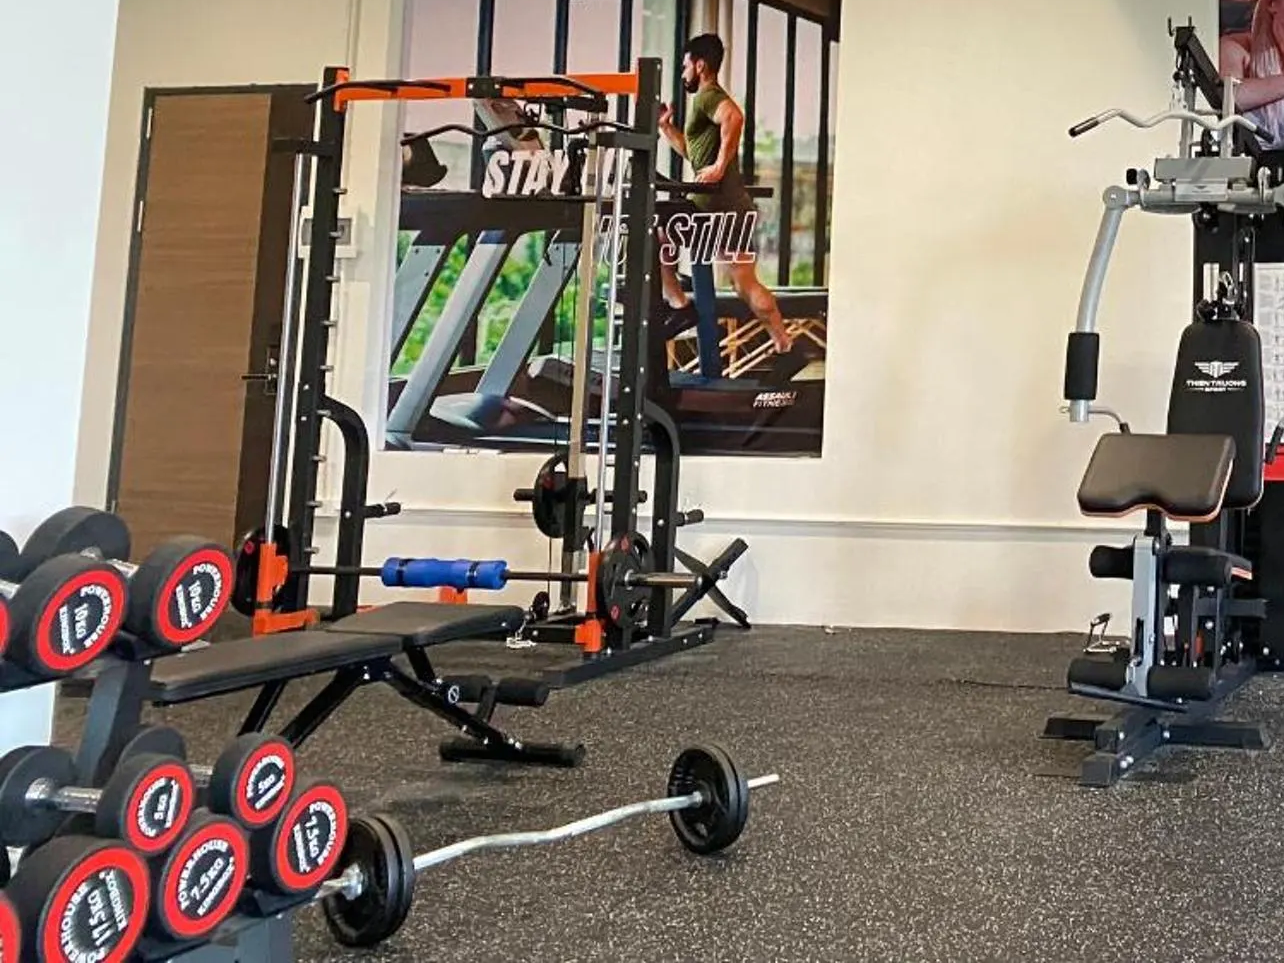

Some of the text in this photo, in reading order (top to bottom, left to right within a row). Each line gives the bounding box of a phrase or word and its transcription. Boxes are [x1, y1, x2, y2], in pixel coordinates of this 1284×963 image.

[483, 148, 571, 199] STAY
[660, 210, 758, 266] STILL
[80, 584, 112, 648] POWERHOUSE
[193, 563, 222, 621] POWERHOUSE
[74, 602, 89, 640] 10KG
[177, 839, 229, 911] POWERHOUSE
